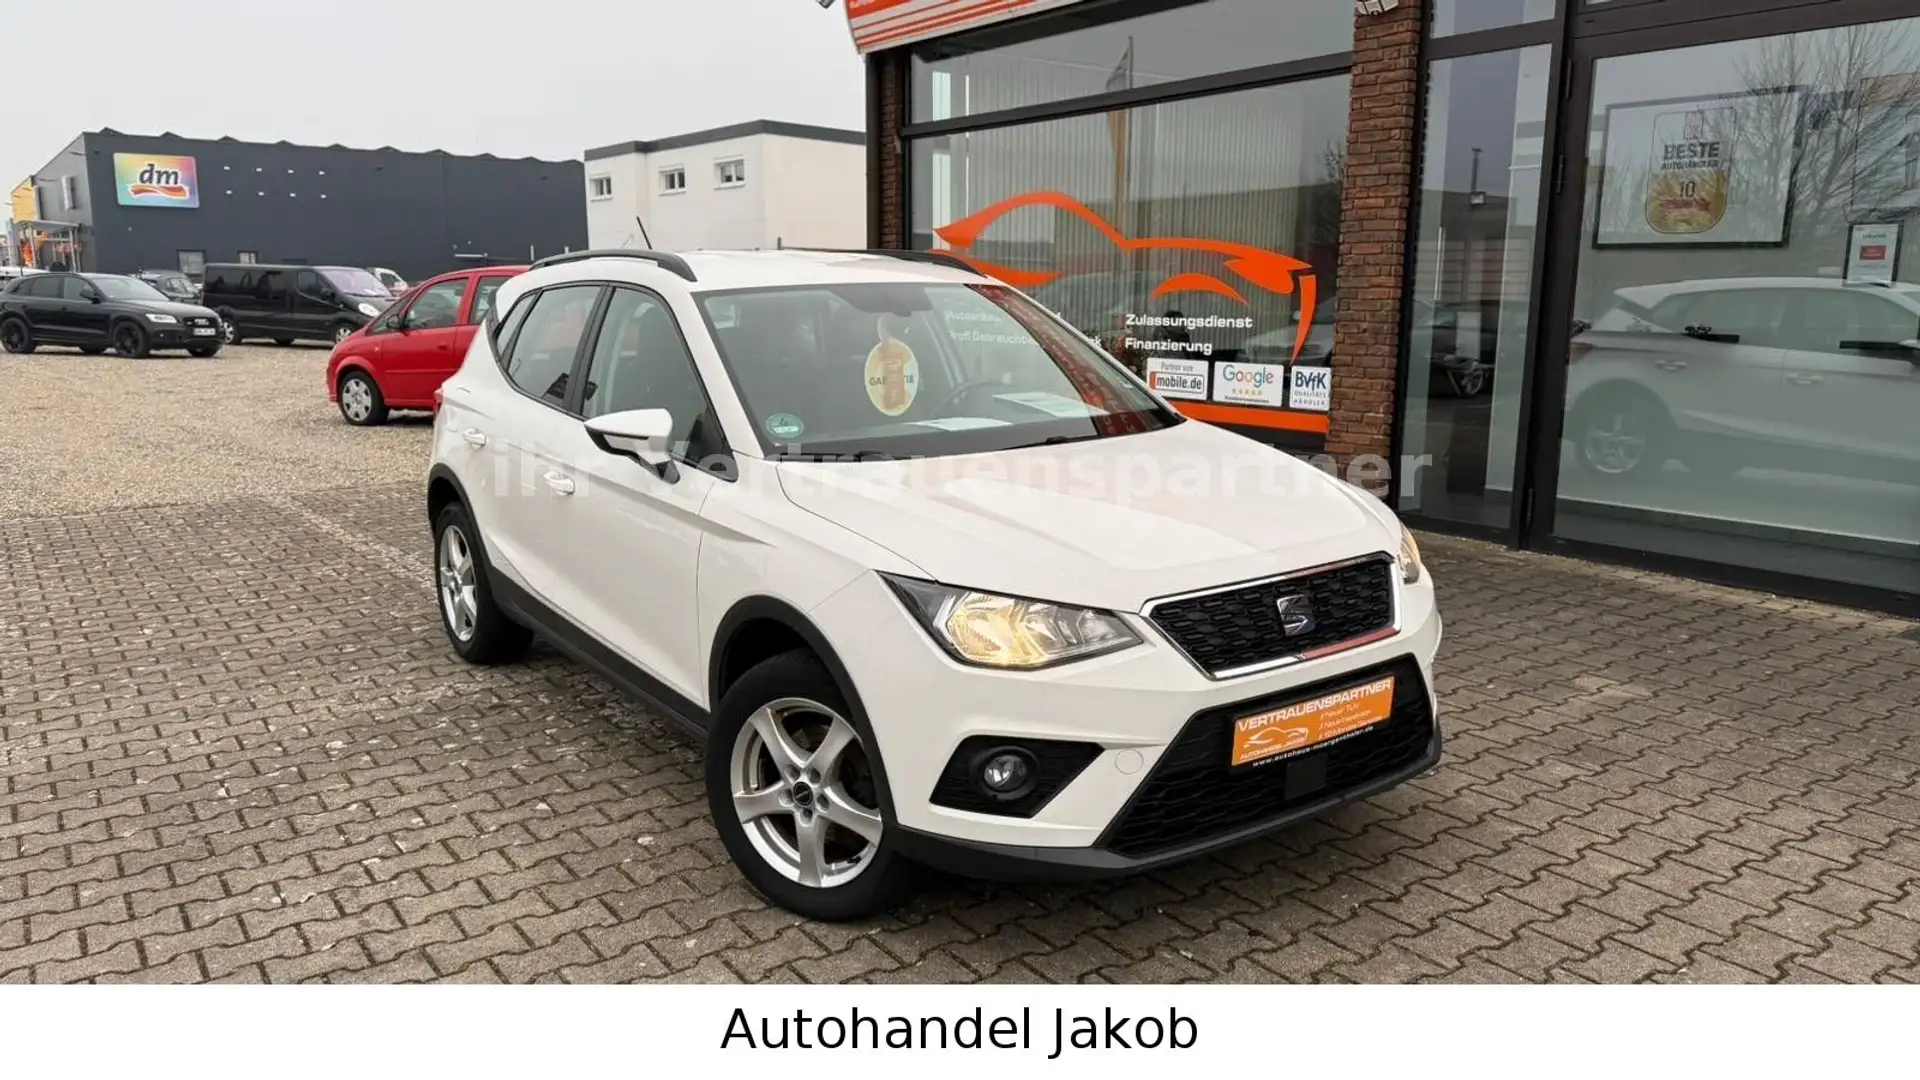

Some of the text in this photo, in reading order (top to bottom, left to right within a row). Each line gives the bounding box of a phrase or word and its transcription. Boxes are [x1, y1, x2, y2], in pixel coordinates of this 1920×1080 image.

[1664, 141, 1720, 160] BESTE
[139, 163, 179, 185] dm
[1126, 313, 1253, 329] Zulassungsdienst
[1125, 337, 1213, 356] Finanzierung
[1156, 374, 1202, 390] mobile.de
[1222, 364, 1274, 386] Google
[1295, 371, 1326, 390] BVfK
[1238, 678, 1392, 732] VERTRAUENSPARTNER
